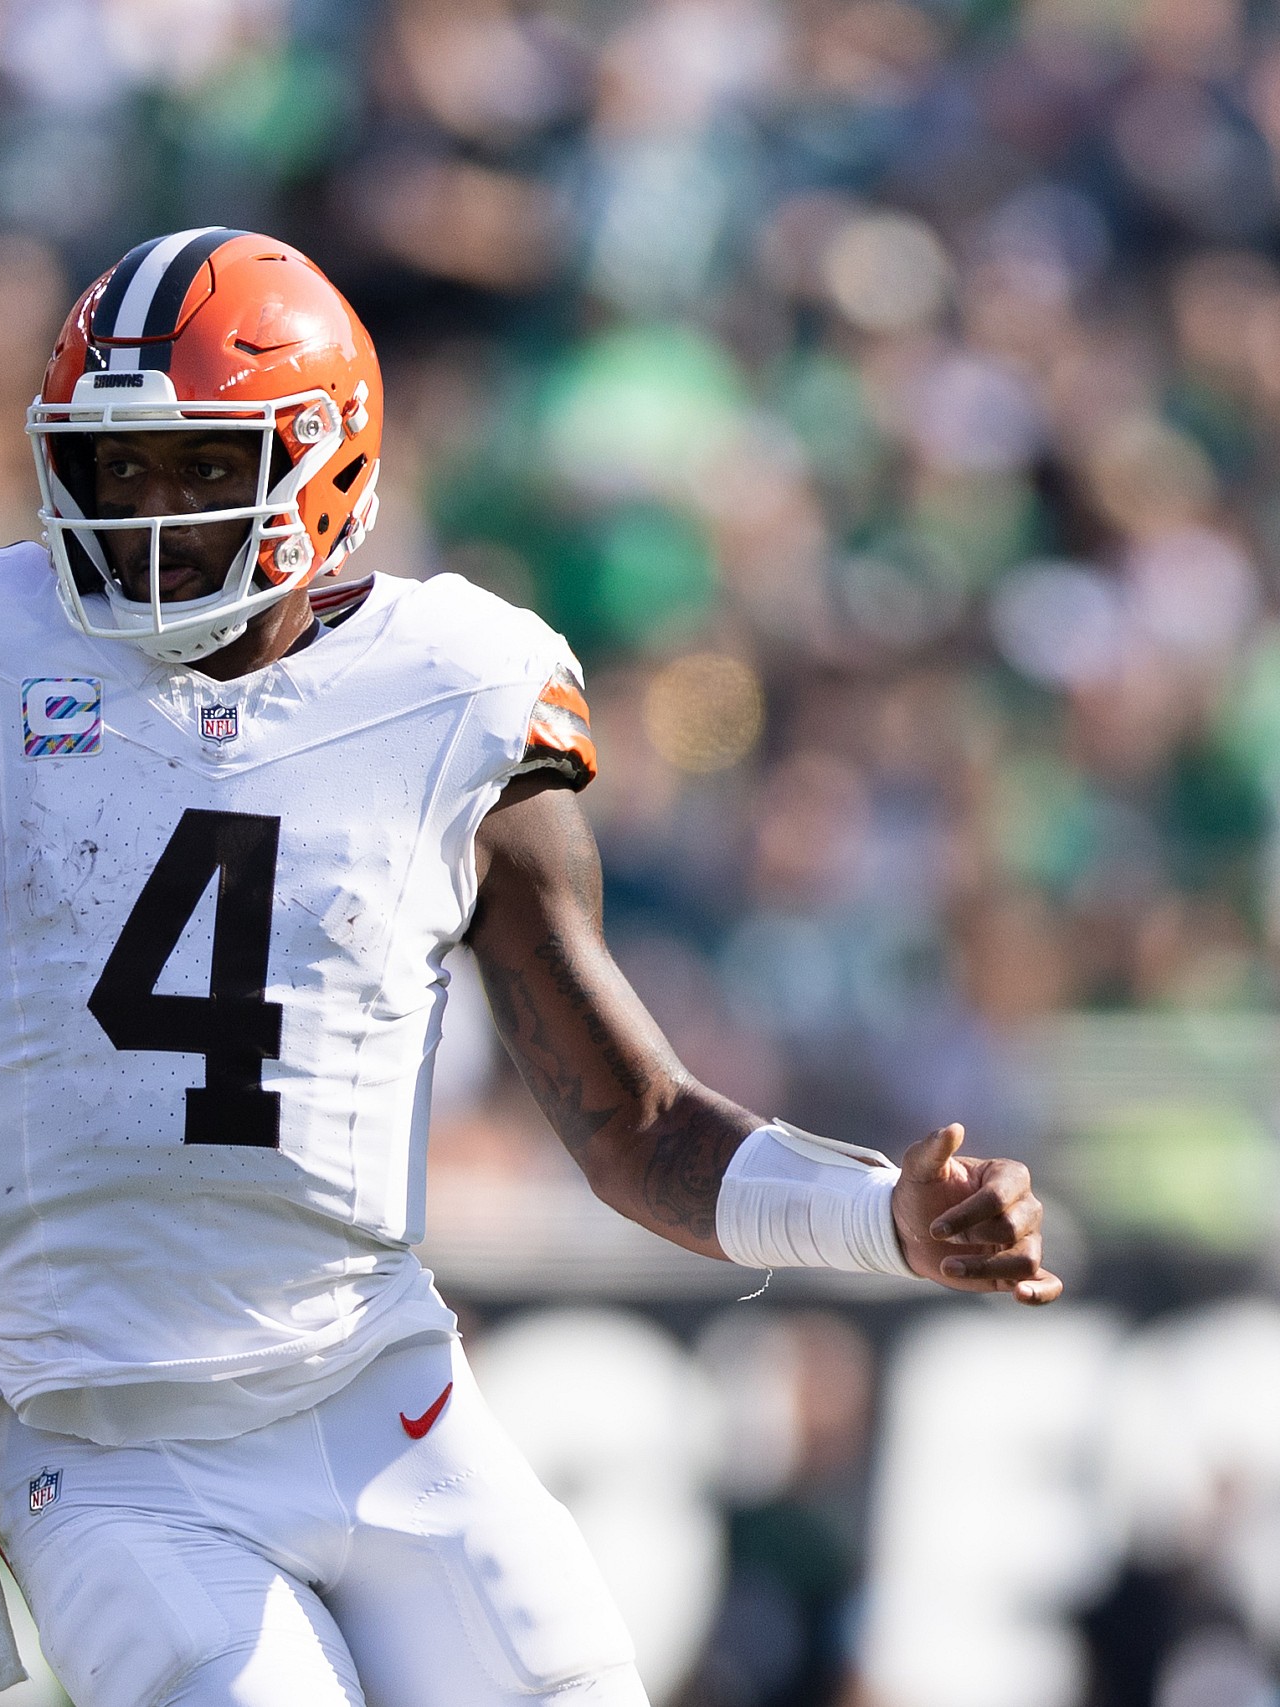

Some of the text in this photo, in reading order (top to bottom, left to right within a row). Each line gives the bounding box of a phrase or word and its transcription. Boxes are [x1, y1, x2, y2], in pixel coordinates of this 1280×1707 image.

[93, 374, 144, 389] BROWNS
[27, 681, 97, 736] C
[205, 720, 233, 735] NFL
[86, 808, 284, 1149] 4
[32, 1486, 54, 1508] NFL
